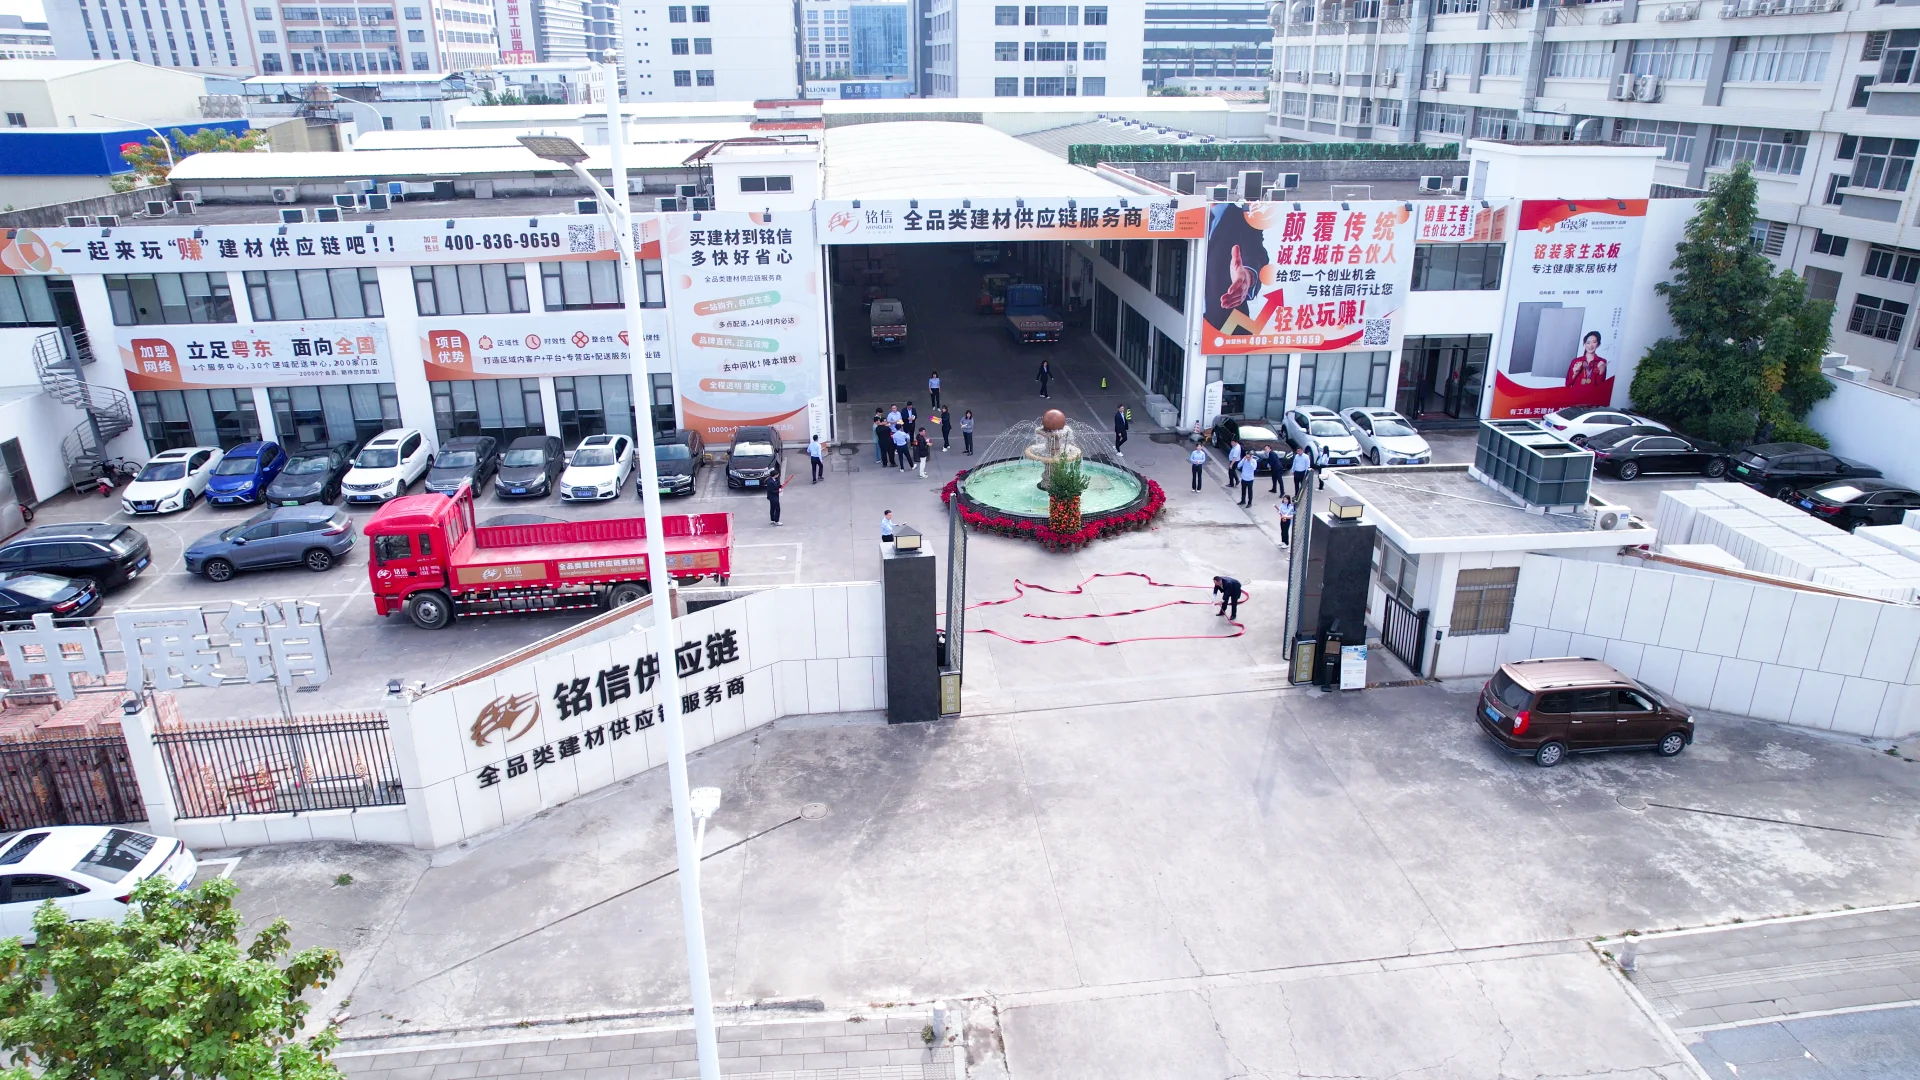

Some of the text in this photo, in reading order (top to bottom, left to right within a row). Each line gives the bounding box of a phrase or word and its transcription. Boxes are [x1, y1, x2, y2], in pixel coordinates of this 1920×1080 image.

[865, 209, 893, 224] 铭信
[903, 206, 1143, 231] 全品类建材供应链服务商
[1424, 204, 1470, 222] 销量王者
[1281, 210, 1398, 243] 颠覆传统
[1422, 223, 1466, 237] 性价比之选
[444, 231, 561, 251] 400-836-9659
[689, 228, 793, 247] 买建材到铭信
[691, 248, 793, 267] 多快好省心
[1276, 243, 1397, 266] 诚招城市合伙人
[1533, 242, 1622, 260] 铭装家生态板
[1275, 268, 1377, 283] 给您一个创业机会
[1531, 262, 1618, 274] 专注健康家居板材
[1306, 283, 1394, 297] 与铭信同行让您
[435, 335, 463, 349] 项目
[497, 338, 520, 347] 区域性
[544, 337, 566, 345] 时效性
[591, 335, 613, 343] 整合性
[642, 334, 661, 342] 牌性
[1249, 334, 1321, 346] 400-836-9659
[139, 345, 169, 358] 加盟
[186, 336, 377, 360] 立足粤东 面向全国
[437, 350, 465, 364] 优势
[143, 360, 173, 373] 网络
[0, 599, 330, 701] 中展销
[553, 628, 740, 722] 铭信供应链
[946, 677, 955, 711] 欢迎光临
[476, 675, 745, 789] 全品类建材供应服务商
